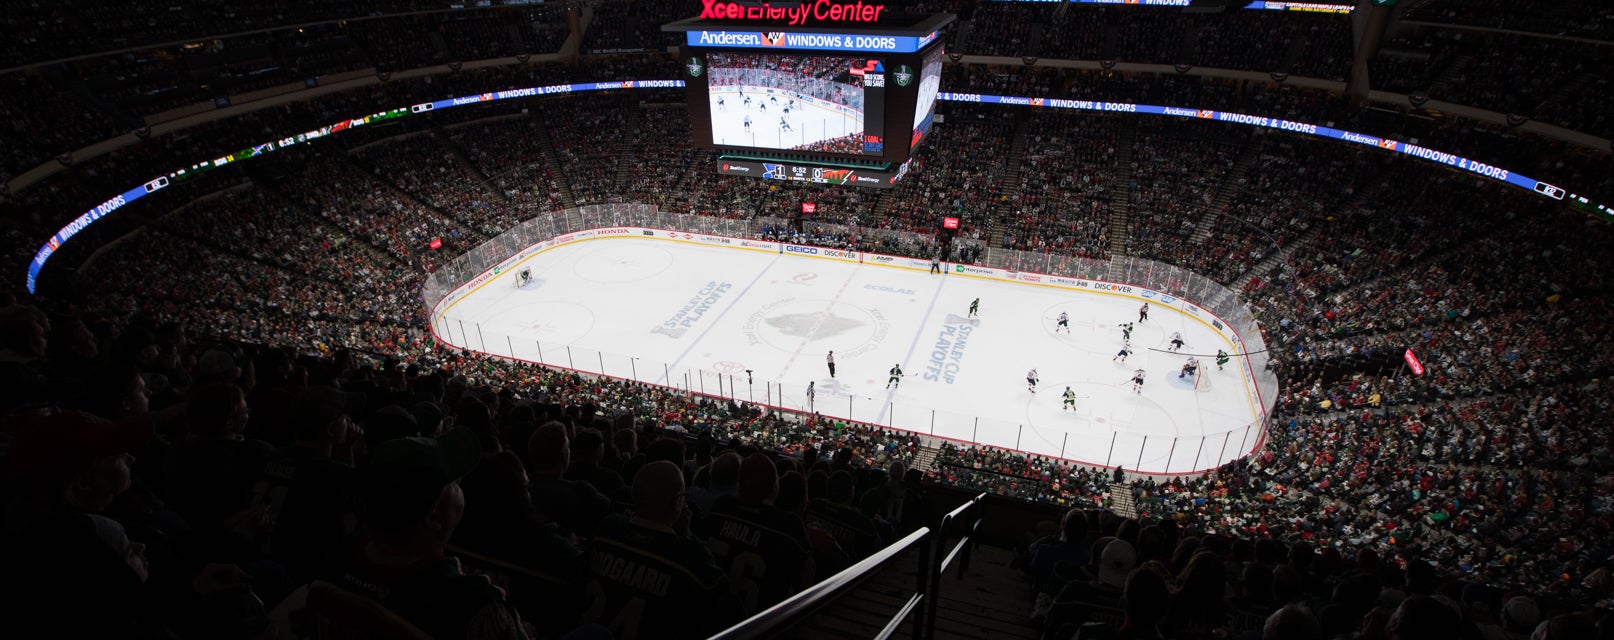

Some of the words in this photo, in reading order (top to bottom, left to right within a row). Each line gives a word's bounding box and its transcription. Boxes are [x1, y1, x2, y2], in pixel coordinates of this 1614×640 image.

[813, 0, 885, 22] Center
[700, 31, 760, 45] Andersen
[787, 36, 841, 48] WINDOWS
[844, 37, 853, 48] &
[856, 37, 896, 49] DOORS
[639, 80, 674, 88] WINDOWS
[453, 95, 480, 106] Andersen
[498, 88, 536, 99] WINDOWS
[546, 84, 572, 95] DOORS
[953, 93, 981, 102] DOORS
[1000, 96, 1029, 105] Andersen
[1050, 99, 1093, 109] WINDOWS
[1095, 102, 1102, 110] &
[1105, 103, 1136, 112] DOORS
[1163, 107, 1197, 117] Andersen
[1220, 112, 1268, 127] WINDOWS
[1270, 118, 1278, 128] &
[1281, 120, 1316, 134] DOORS
[279, 137, 294, 147] 6:52
[1341, 131, 1378, 145] Andersen
[1404, 144, 1456, 165] WINDOWS
[1458, 158, 1467, 168] &
[1469, 160, 1509, 180] DOORS
[792, 166, 806, 174] 6:52
[814, 169, 821, 178] 0
[58, 213, 93, 241] WINDOWS
[90, 209, 99, 220] &
[97, 195, 126, 216] DOORS
[597, 228, 630, 236] HONDA
[786, 245, 818, 255] GEICO
[824, 249, 856, 260] DISCOVER
[468, 273, 493, 289] HONDA
[1094, 282, 1132, 294] DISCOVER
[664, 291, 704, 328] STANLEY
[699, 280, 718, 297] CUP
[681, 282, 732, 328] PLAYOFFS
[923, 325, 956, 382] PLAYOFFS
[950, 325, 973, 363] STANLEY
[943, 362, 960, 384] CUP
[720, 520, 761, 548] HAULA
